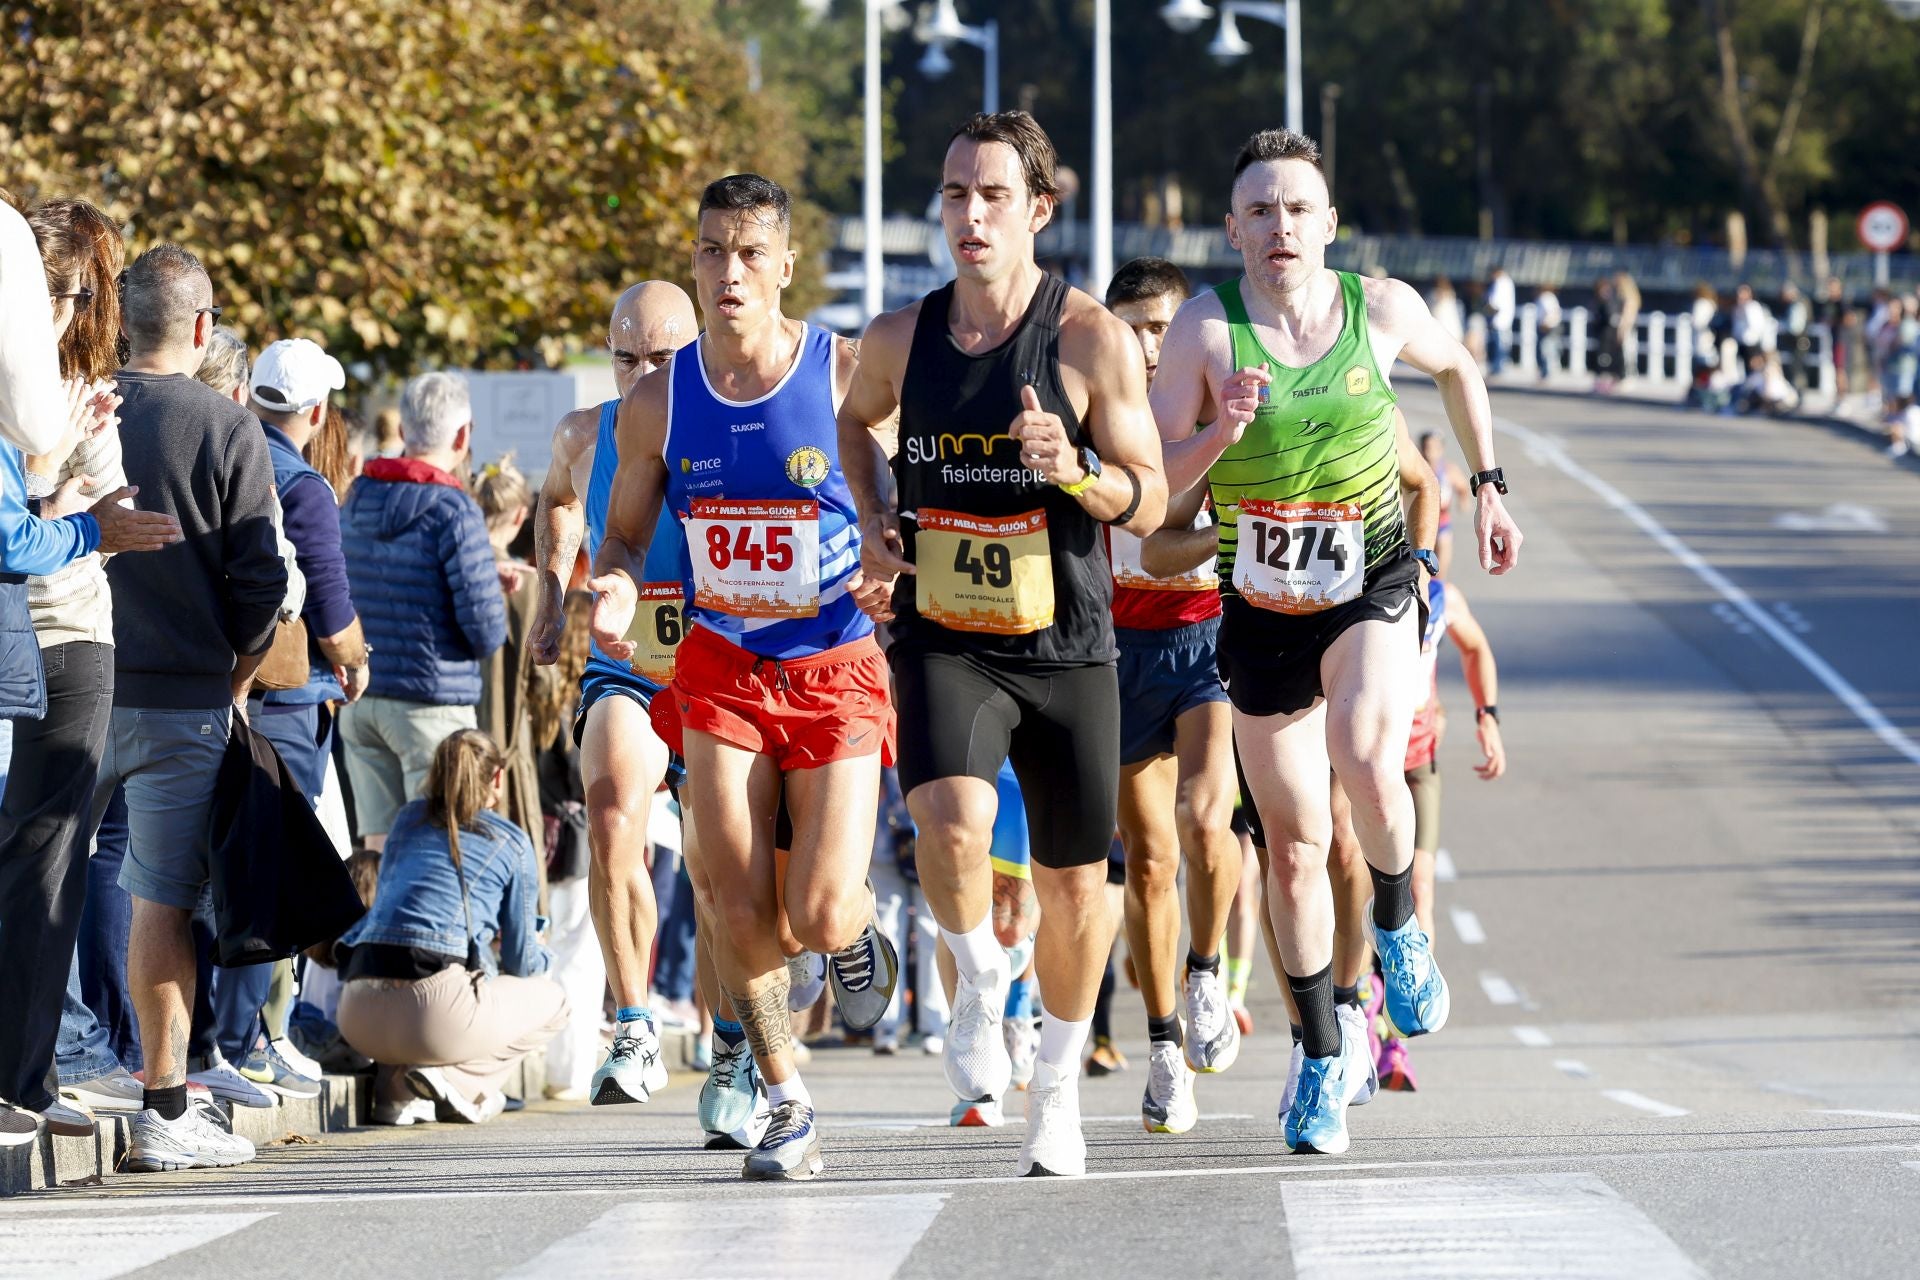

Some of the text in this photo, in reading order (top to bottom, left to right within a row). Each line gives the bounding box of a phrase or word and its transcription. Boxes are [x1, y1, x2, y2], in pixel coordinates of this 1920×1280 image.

[1292, 386, 1328, 398] FASTER
[730, 422, 765, 433] SUKAN
[692, 457, 721, 471] ence
[720, 506, 746, 515] MBA
[768, 505, 797, 515] GIJÓN
[1274, 508, 1297, 517] MBA
[1318, 507, 1344, 517] GIJÓN
[953, 518, 978, 531] MBA
[999, 519, 1027, 532] GIJÓN
[705, 525, 794, 572] 845
[1252, 521, 1347, 571] 1274
[954, 539, 1012, 588] 49
[743, 579, 785, 587] FERNÁNDEZ
[653, 587, 677, 595] MBA
[978, 594, 1015, 603] GONZÁLEZ
[655, 604, 686, 646] 6
